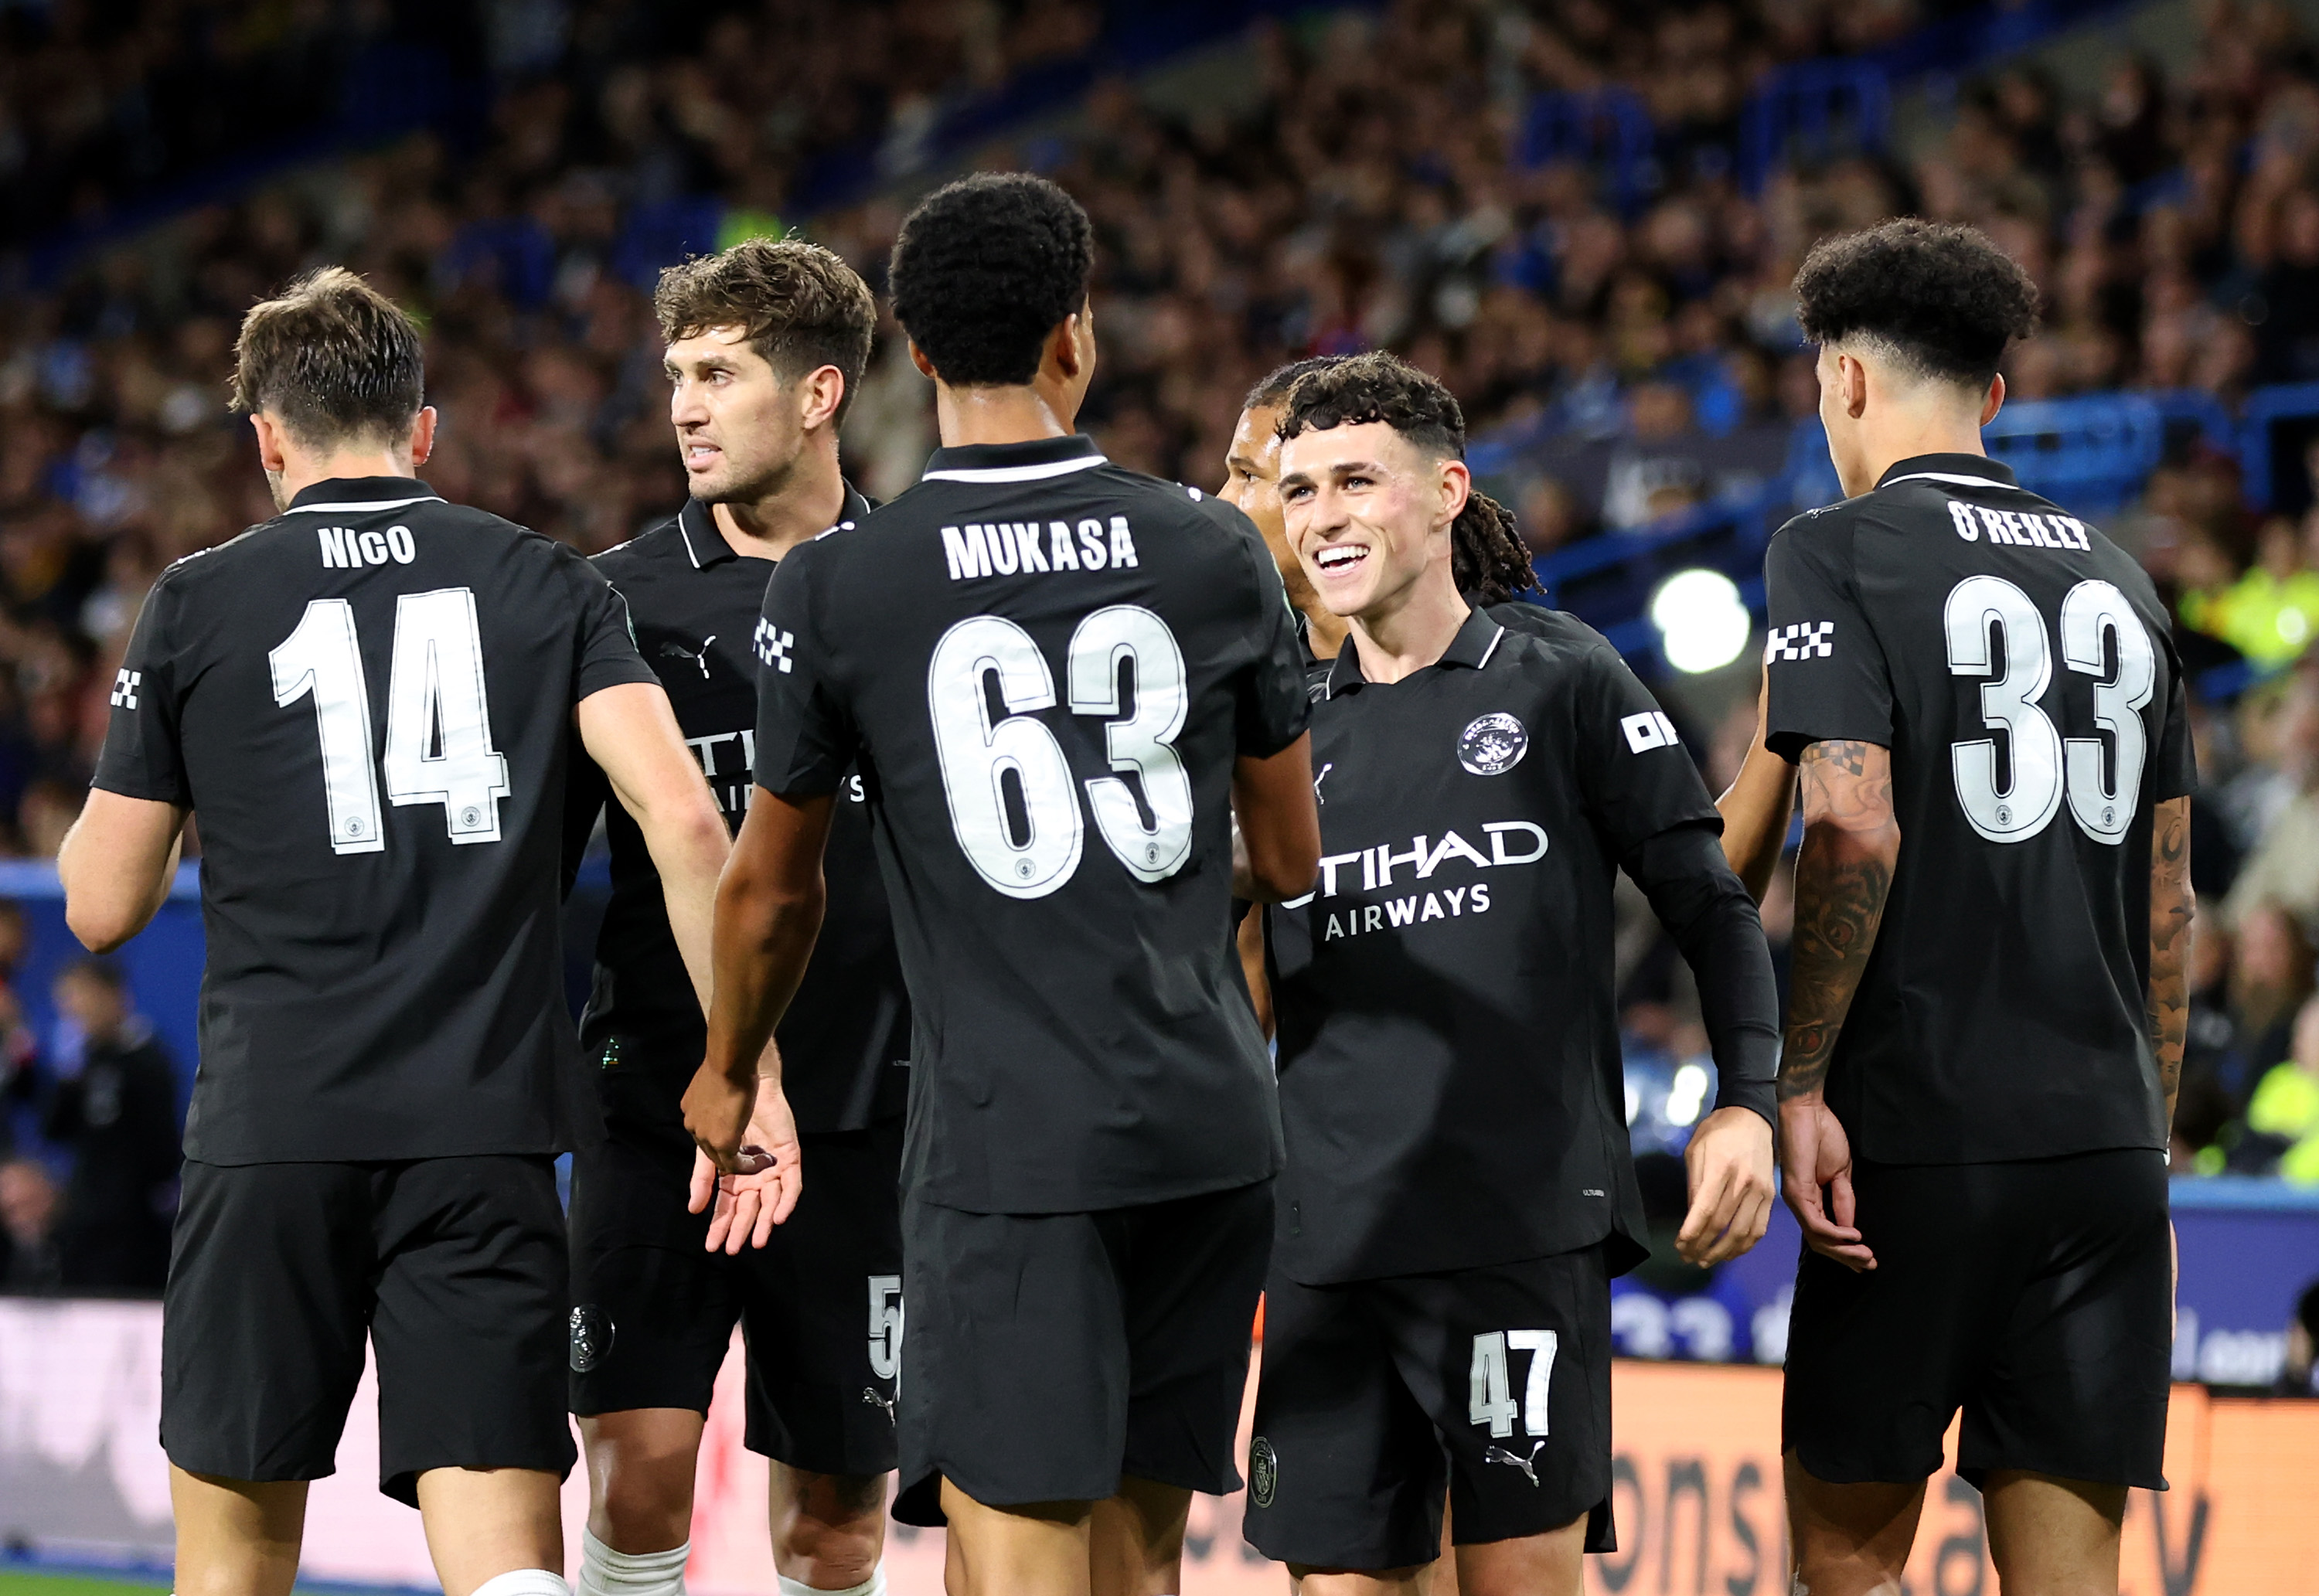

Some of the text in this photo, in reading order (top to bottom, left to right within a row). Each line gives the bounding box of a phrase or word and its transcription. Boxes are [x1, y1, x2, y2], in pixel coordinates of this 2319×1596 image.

[317, 524, 416, 569] NICO
[939, 516, 1139, 581] MUKASA
[1946, 499, 2092, 553] O'REILLY
[1766, 621, 1835, 665] KX
[268, 586, 512, 856] 14
[927, 603, 1195, 900] 63
[1943, 574, 2157, 846] 33
[1280, 820, 1549, 910] TIHAD
[1324, 883, 1491, 942] AIRWAYS
[867, 1274, 904, 1379] 5
[1468, 1329, 1558, 1438] 47
